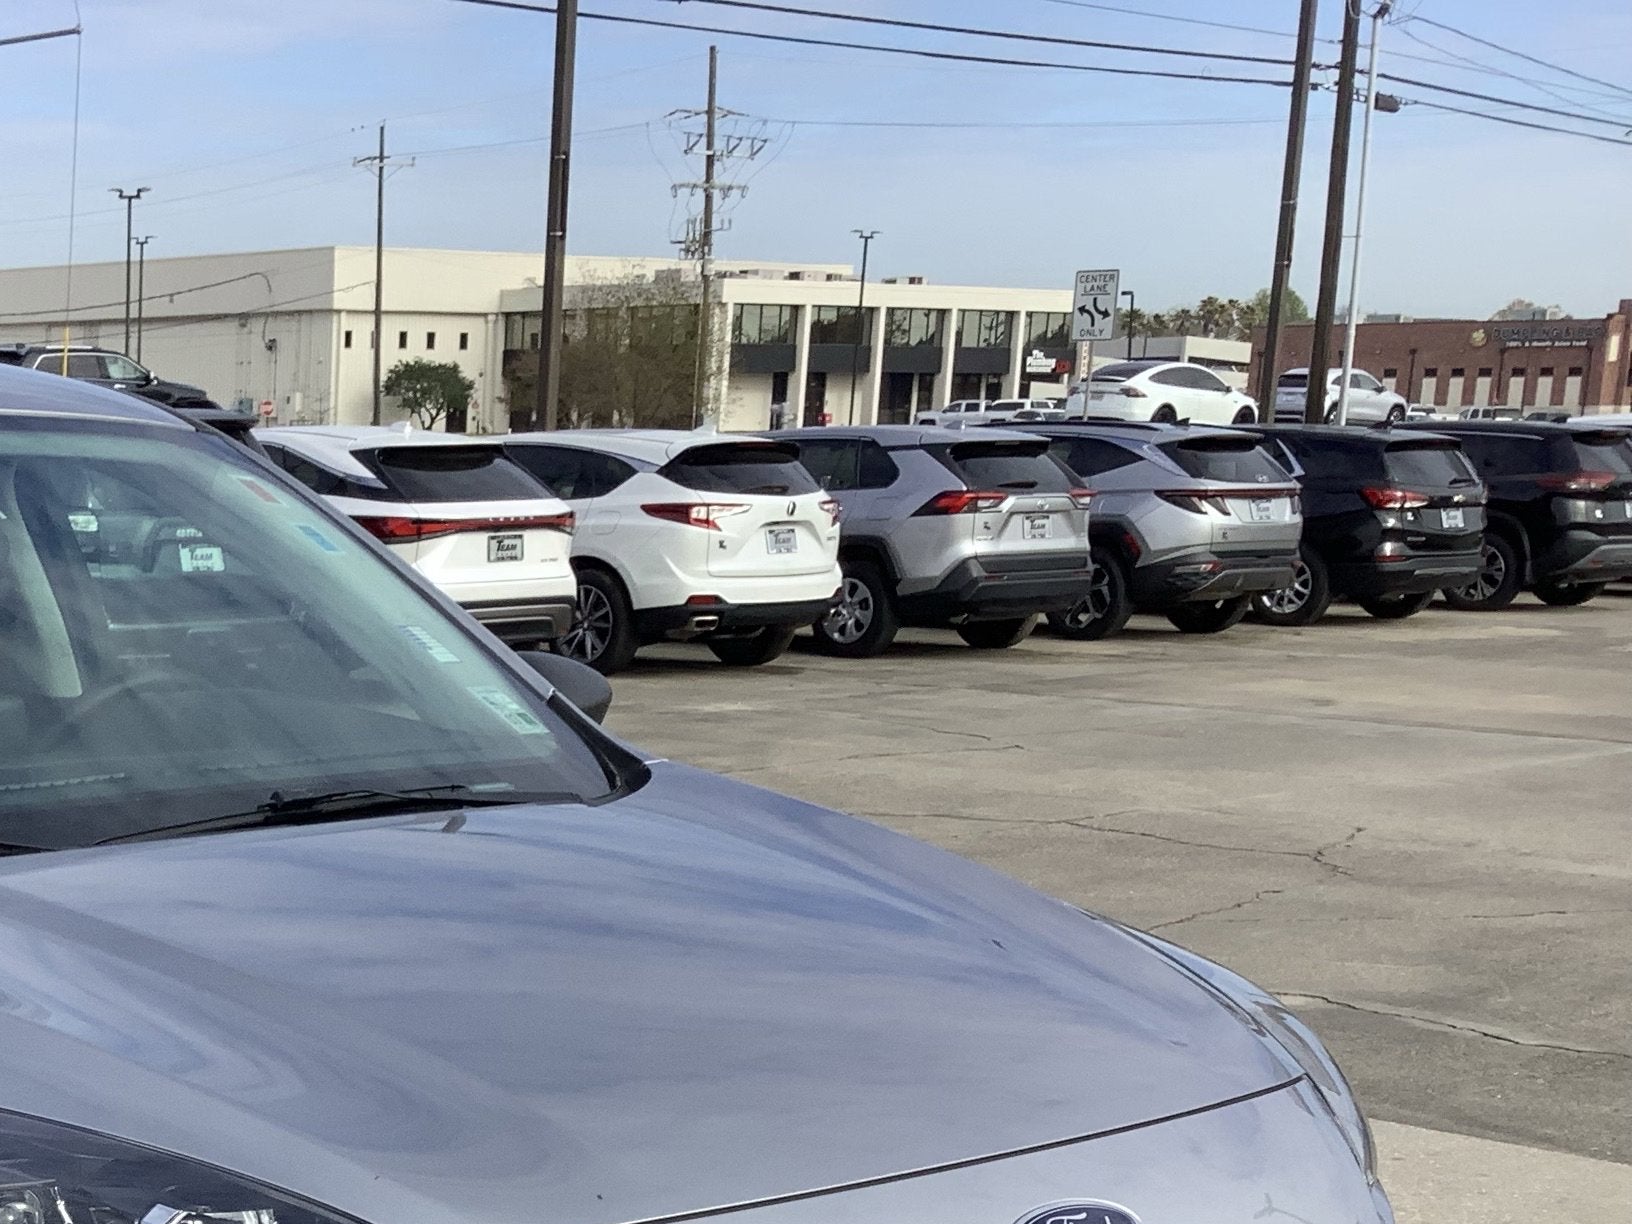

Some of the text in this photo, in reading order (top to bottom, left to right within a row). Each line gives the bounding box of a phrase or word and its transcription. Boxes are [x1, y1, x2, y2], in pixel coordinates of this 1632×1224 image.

[1079, 274, 1115, 283] CENTER
[1084, 284, 1109, 293] LANE
[1079, 329, 1105, 338] ONLY
